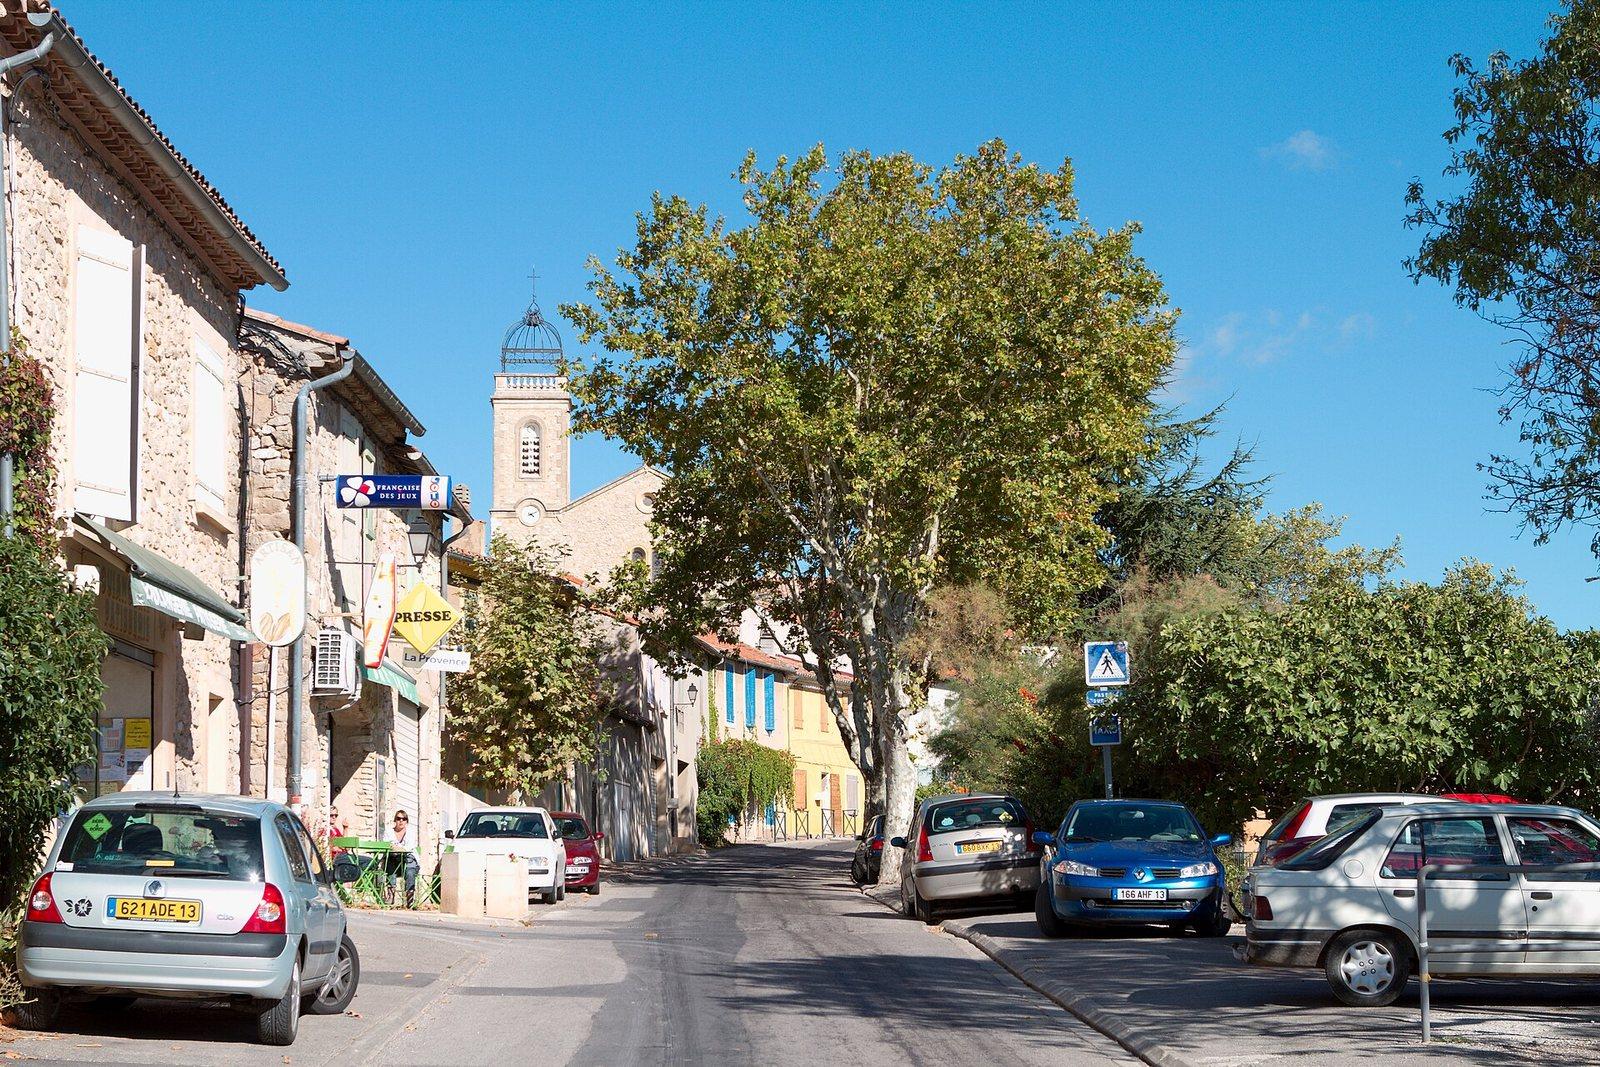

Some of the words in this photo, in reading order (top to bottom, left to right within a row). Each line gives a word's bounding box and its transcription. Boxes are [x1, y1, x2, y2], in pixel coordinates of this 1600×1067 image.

[395, 610, 451, 622] PRESSE
[404, 653, 416, 661] La
[419, 653, 467, 665] Provence
[1121, 890, 1136, 899] 166
[1137, 890, 1152, 899] AHF
[1155, 890, 1165, 899] 13
[121, 902, 145, 915] 621
[149, 903, 176, 917] ADE
[180, 904, 196, 918] 13
[217, 913, 235, 921] Clio
